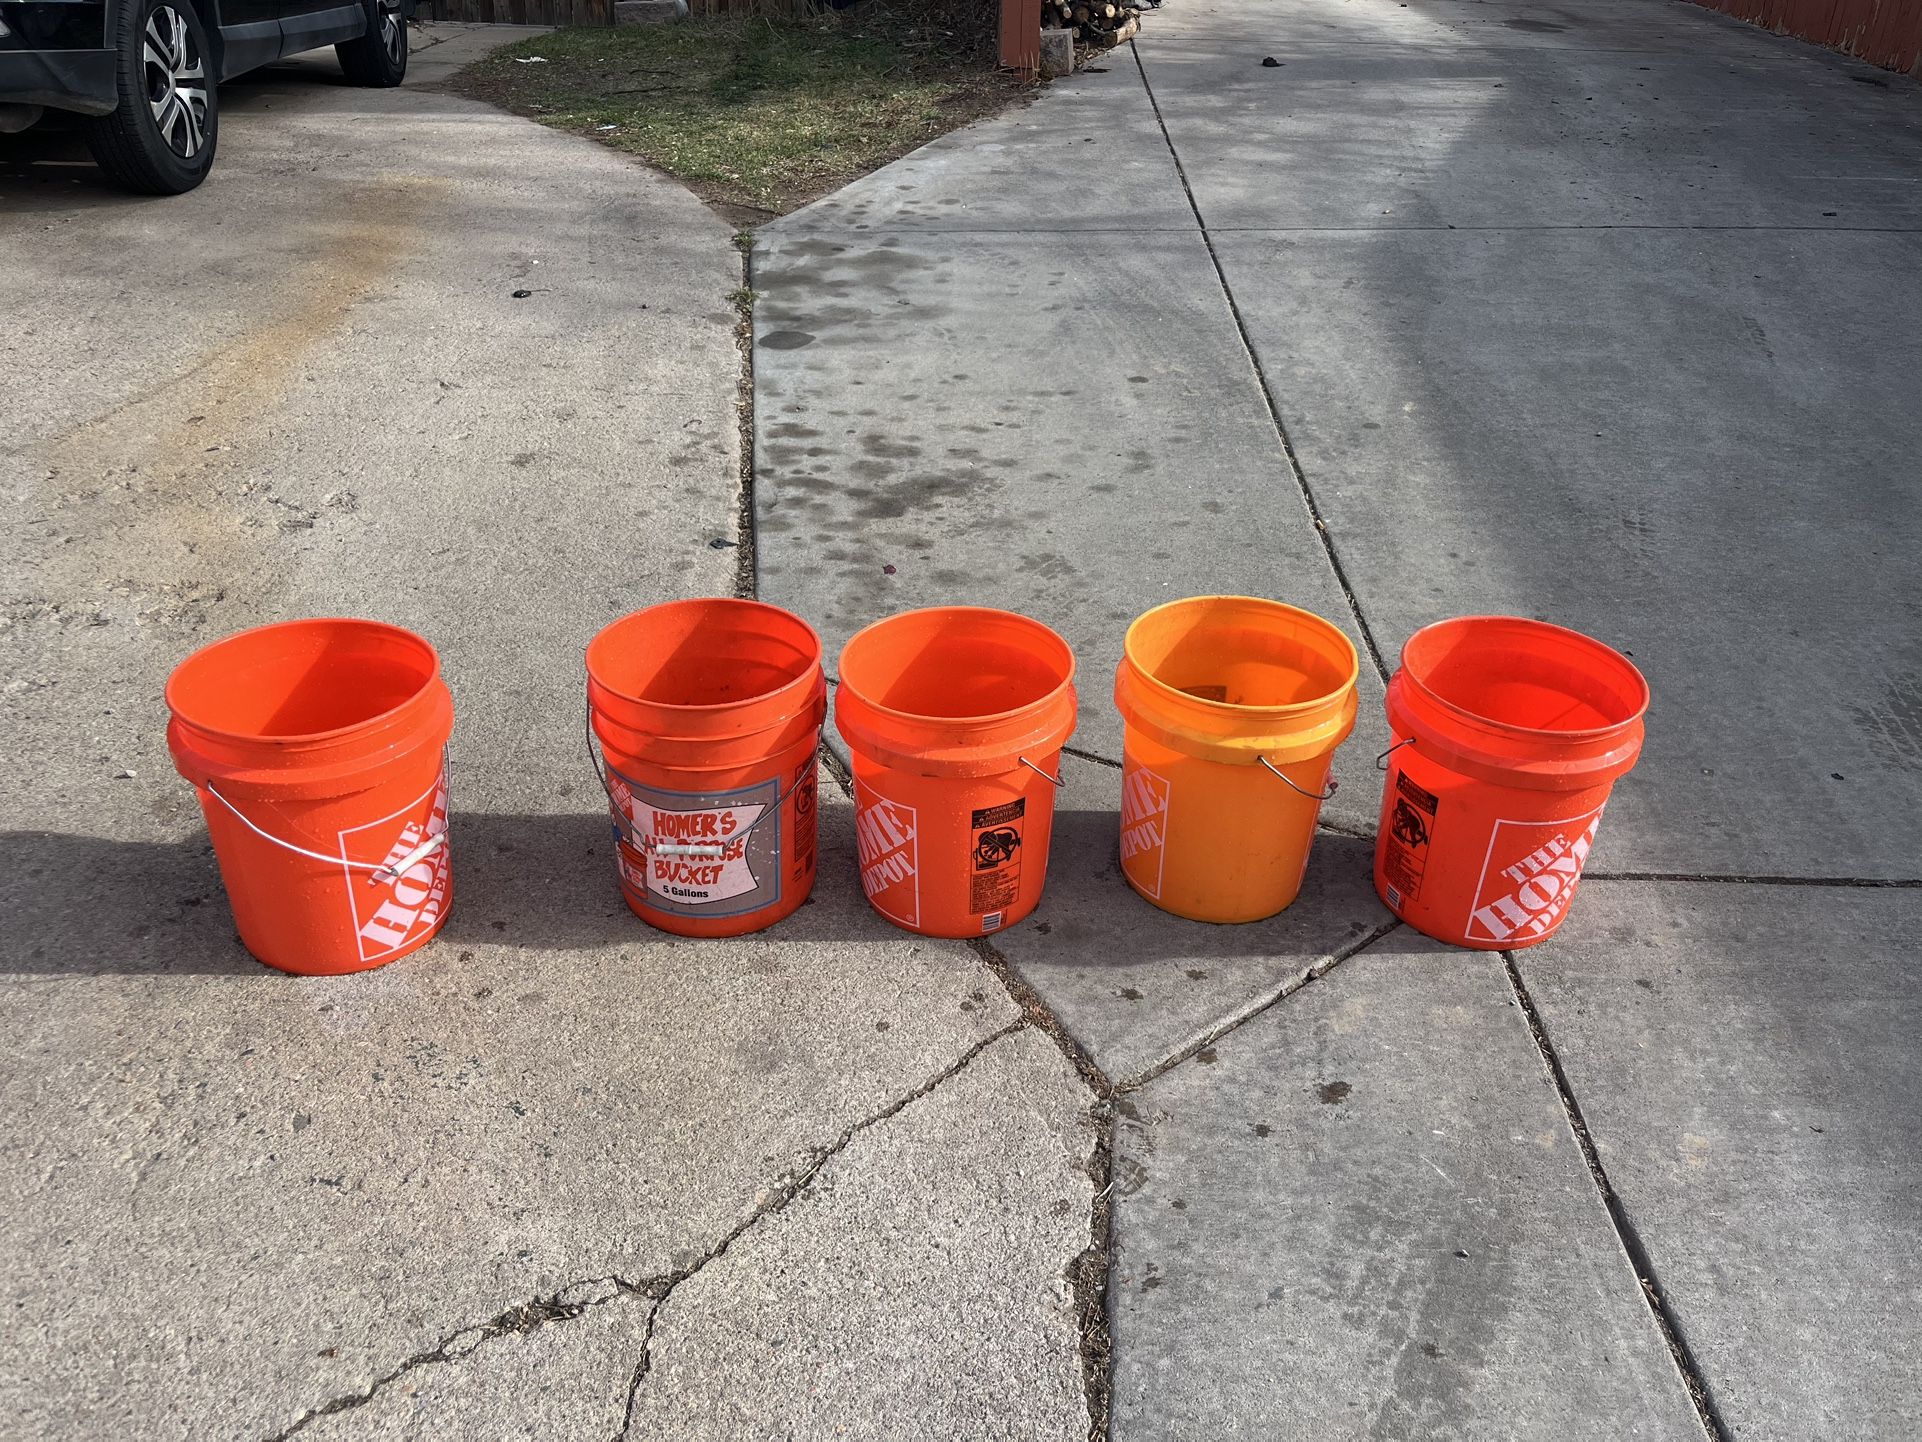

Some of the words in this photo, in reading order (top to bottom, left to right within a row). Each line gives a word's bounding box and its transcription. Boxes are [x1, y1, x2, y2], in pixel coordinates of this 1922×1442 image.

[1123, 767, 1166, 827] ME
[652, 811, 737, 838] HOMER'S
[368, 821, 424, 887] THE
[654, 860, 724, 885] BUCKET
[862, 850, 915, 897] DEPOT
[1500, 833, 1571, 884] THE
[663, 885, 670, 894] 5
[671, 886, 709, 898] Gallons
